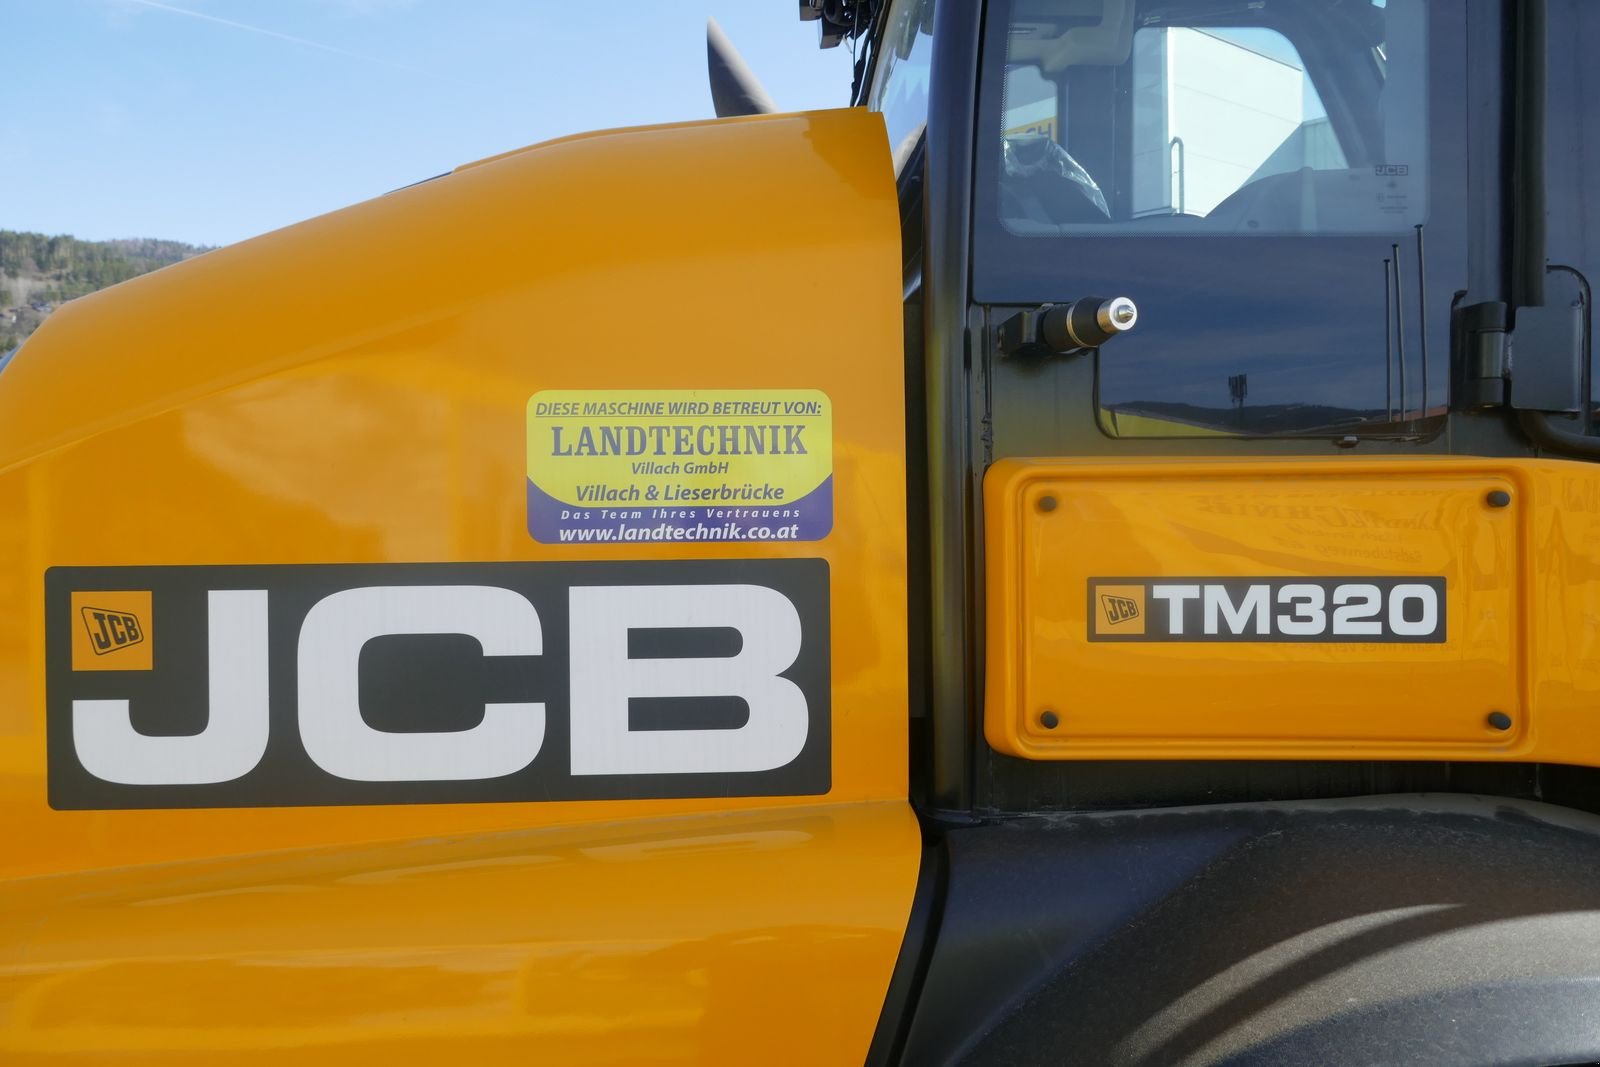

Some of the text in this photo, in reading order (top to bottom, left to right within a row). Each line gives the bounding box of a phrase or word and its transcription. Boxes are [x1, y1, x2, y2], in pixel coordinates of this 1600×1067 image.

[535, 401, 822, 415] DIESE MASCHINE WIRD BETREUT VON:
[551, 424, 807, 456] LANDTECHNIK
[631, 461, 729, 475] Villach GmbH
[575, 484, 784, 502] Villach & Lieserbrücke
[561, 508, 800, 520] Das Team Ihres Vertrauens
[559, 523, 799, 542] www.landtechnik.co.at
[1107, 600, 1138, 622] JCB
[1152, 584, 1438, 635] TM320
[92, 612, 140, 649] JCB
[71, 583, 810, 785] JCB
